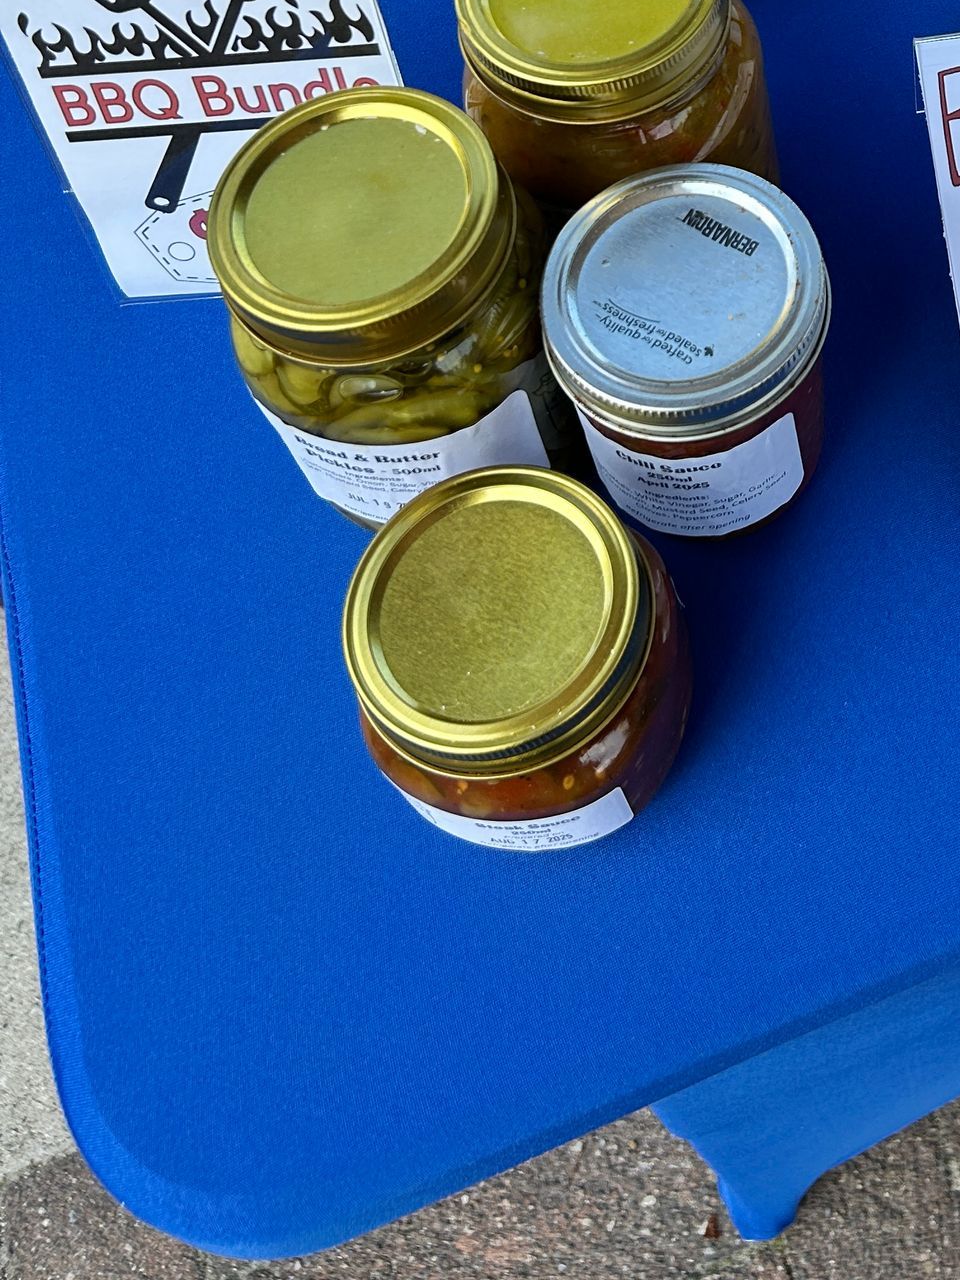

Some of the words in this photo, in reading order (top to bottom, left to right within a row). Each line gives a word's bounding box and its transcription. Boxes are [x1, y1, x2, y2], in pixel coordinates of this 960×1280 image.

[52, 78, 184, 127] BBQ
[682, 208, 760, 257] BERNARDIN
[602, 301, 656, 336] freshness
[649, 338, 693, 365] crafted
[663, 331, 702, 357] sealed
[294, 434, 348, 460] Bread
[354, 452, 369, 463] &
[374, 451, 441, 464] Butter
[305, 448, 375, 474] Pickles
[392, 464, 441, 475] 500ml
[648, 472, 693, 482] 250ml
[660, 462, 722, 474] Sauce
[637, 476, 670, 489] April
[673, 481, 710, 490] 2025
[644, 489, 710, 502] Ingredients:
[732, 491, 763, 507] Celery
[708, 514, 751, 530] opening
